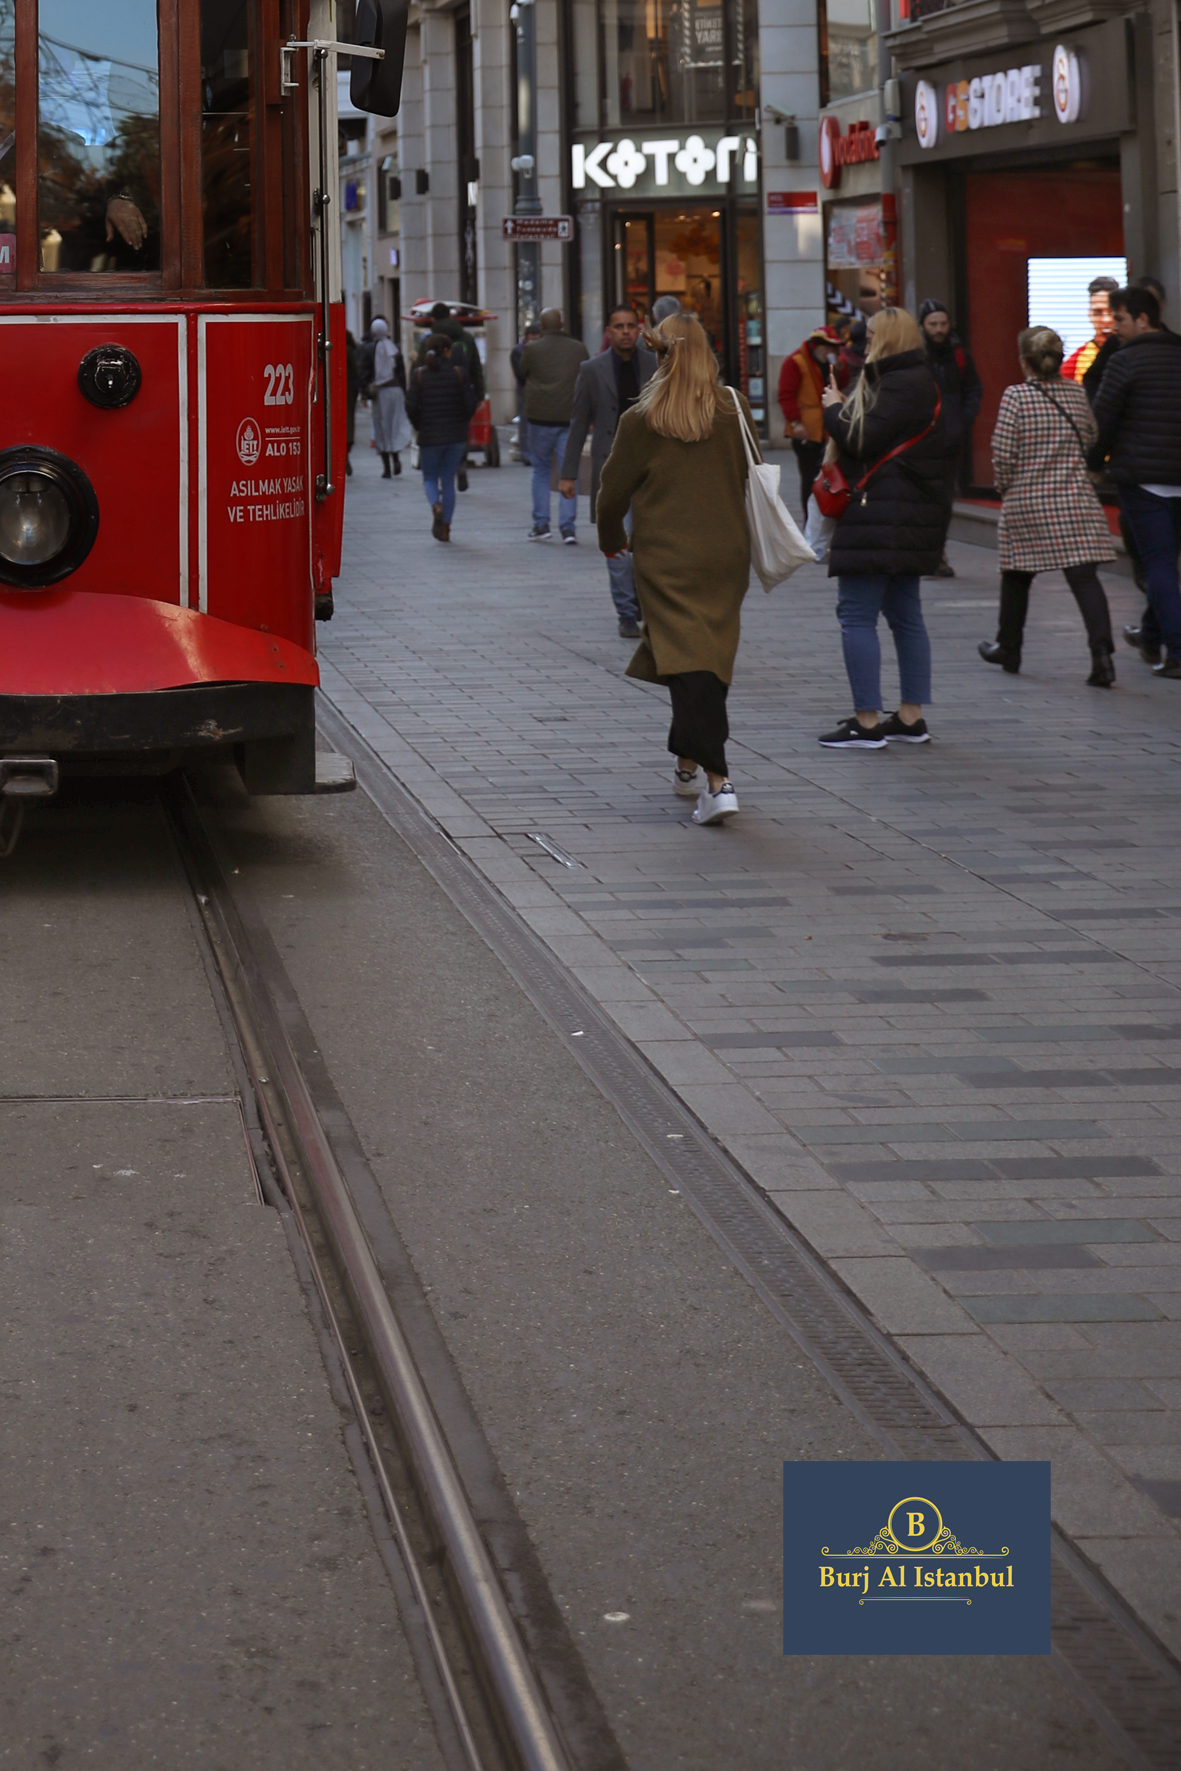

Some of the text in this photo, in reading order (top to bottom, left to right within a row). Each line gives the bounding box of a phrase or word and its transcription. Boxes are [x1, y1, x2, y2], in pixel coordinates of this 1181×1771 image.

[264, 363, 293, 405] 223
[265, 442, 301, 456] ALO 153
[230, 475, 304, 497] ASILMAK YASAK
[227, 497, 305, 522] VE TEHLİKELİDİR
